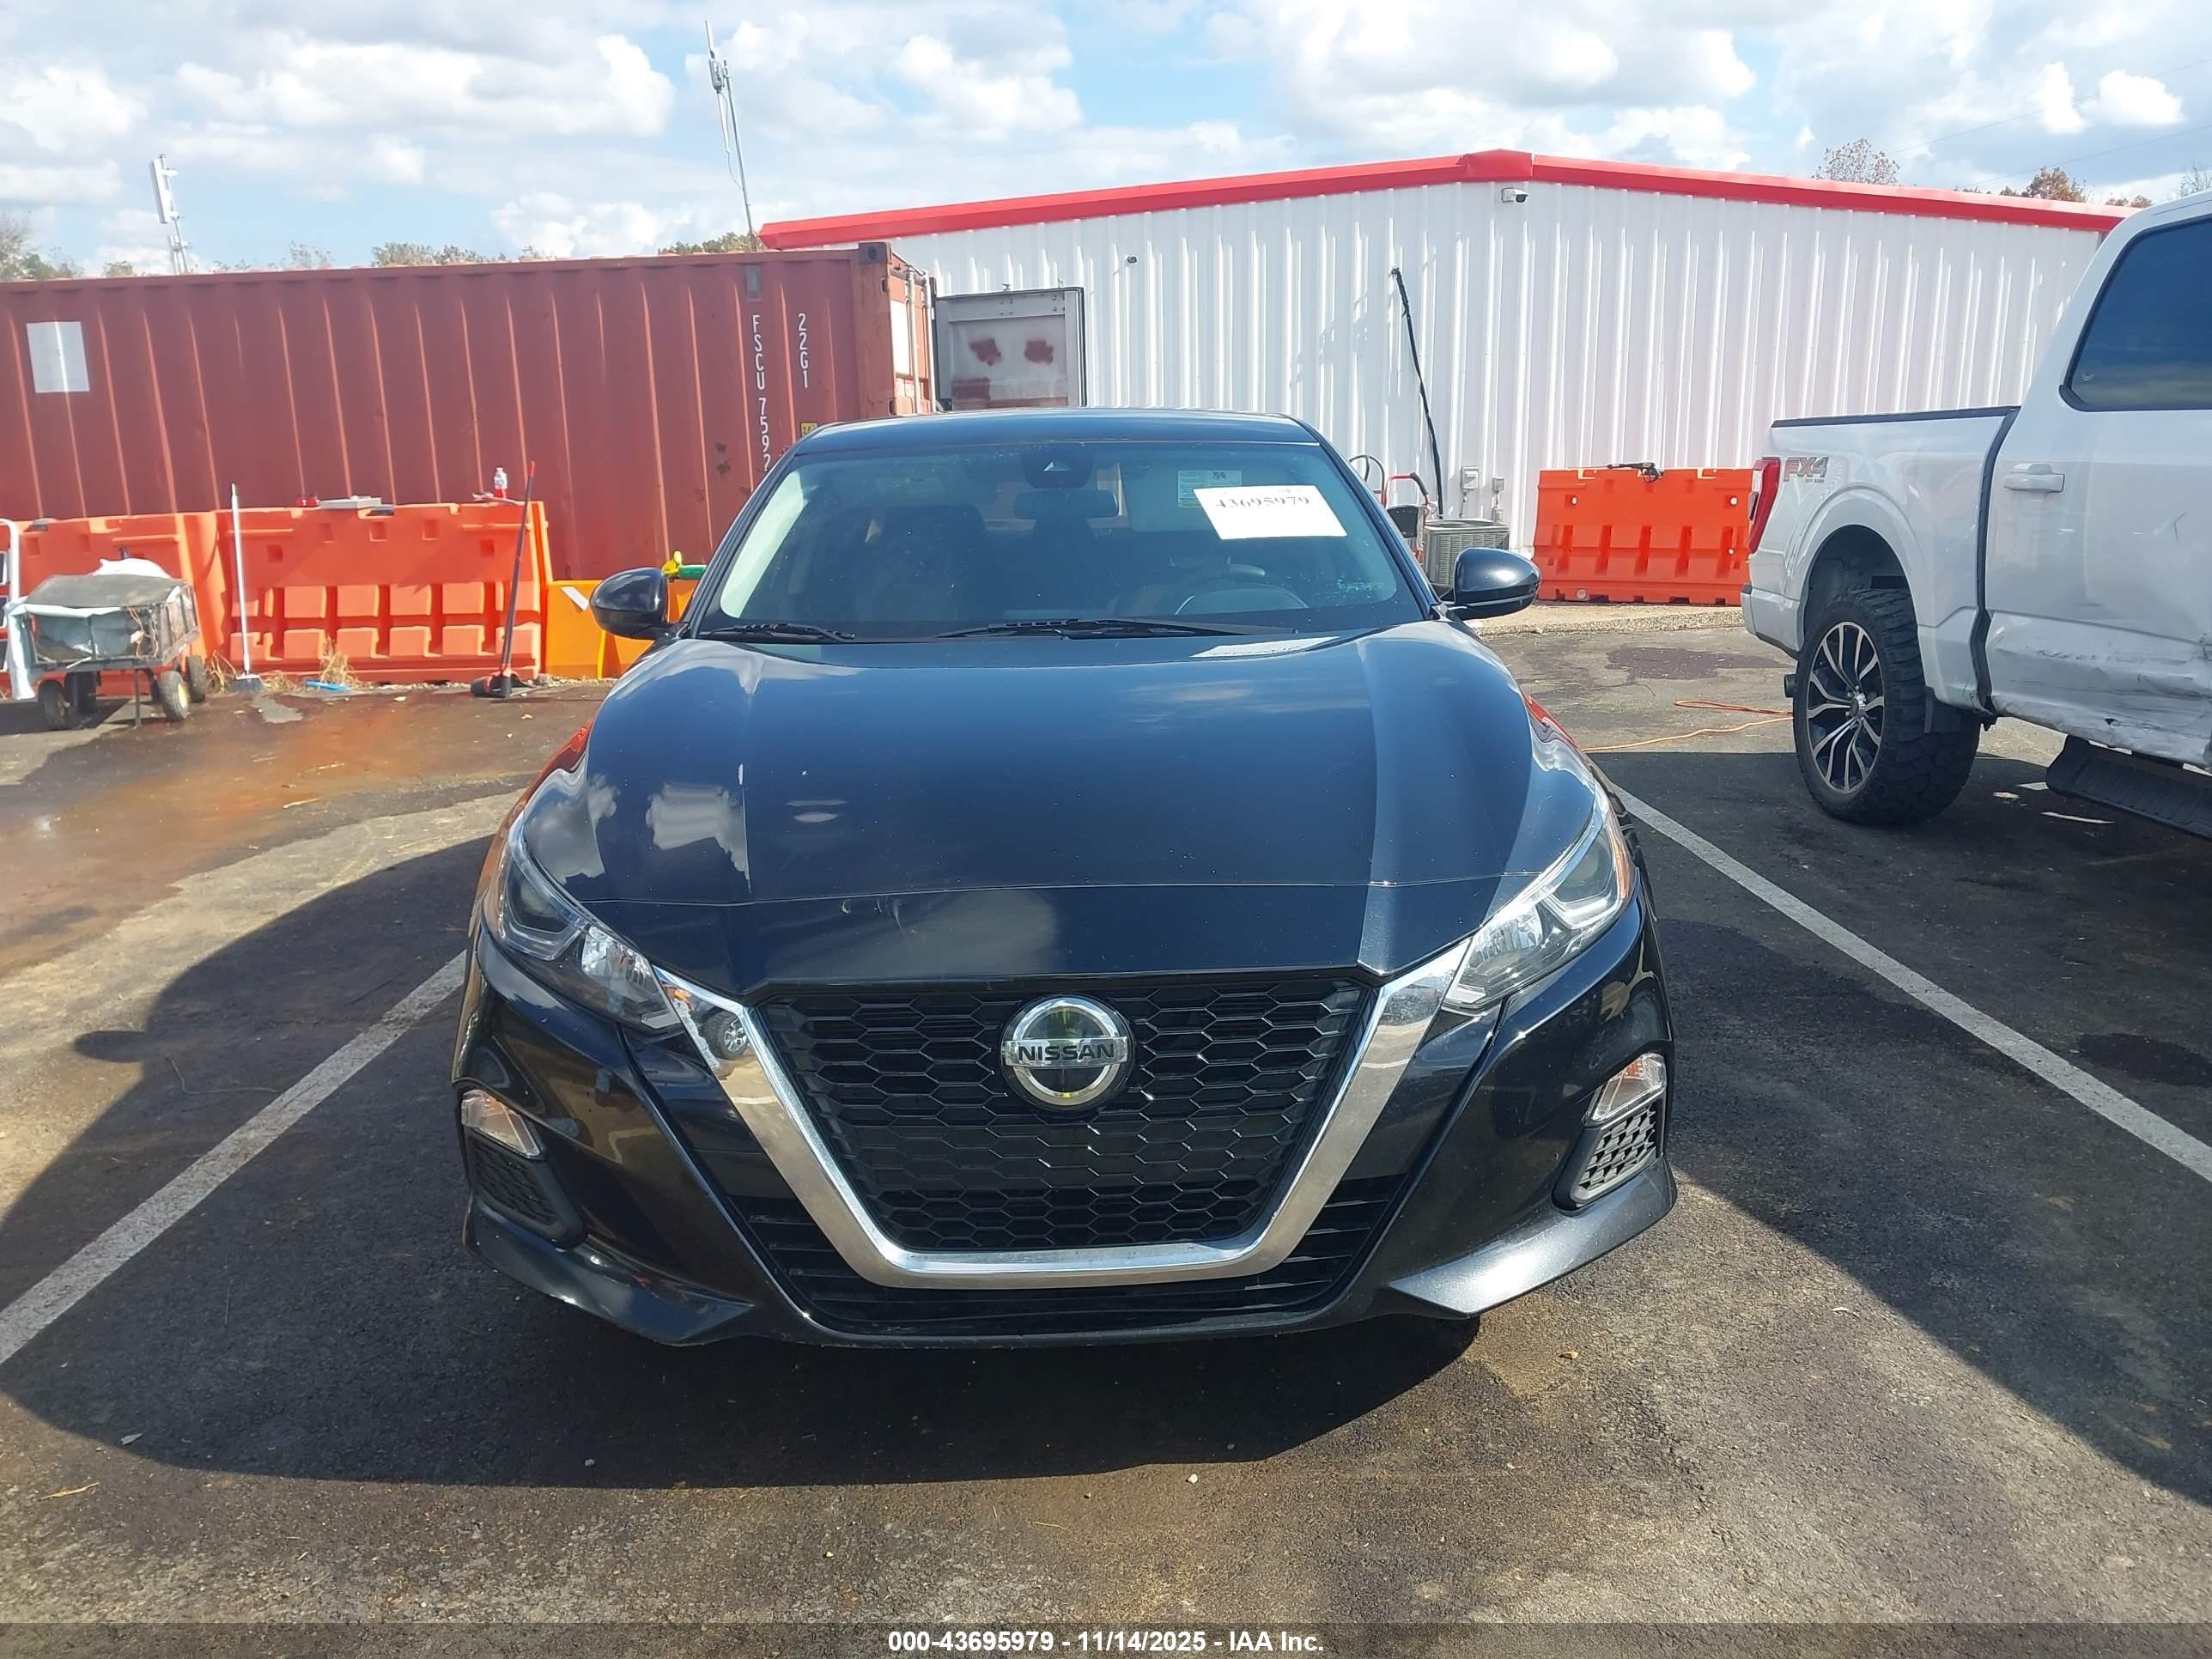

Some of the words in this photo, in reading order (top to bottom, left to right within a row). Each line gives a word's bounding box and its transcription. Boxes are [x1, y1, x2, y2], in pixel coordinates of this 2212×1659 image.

[752, 314, 765, 390] FSCU
[798, 313, 809, 388] 22G1
[1784, 456, 1829, 482] FX4
[1216, 495, 1310, 508] 43695979
[1018, 1043, 1115, 1061] NISSAN
